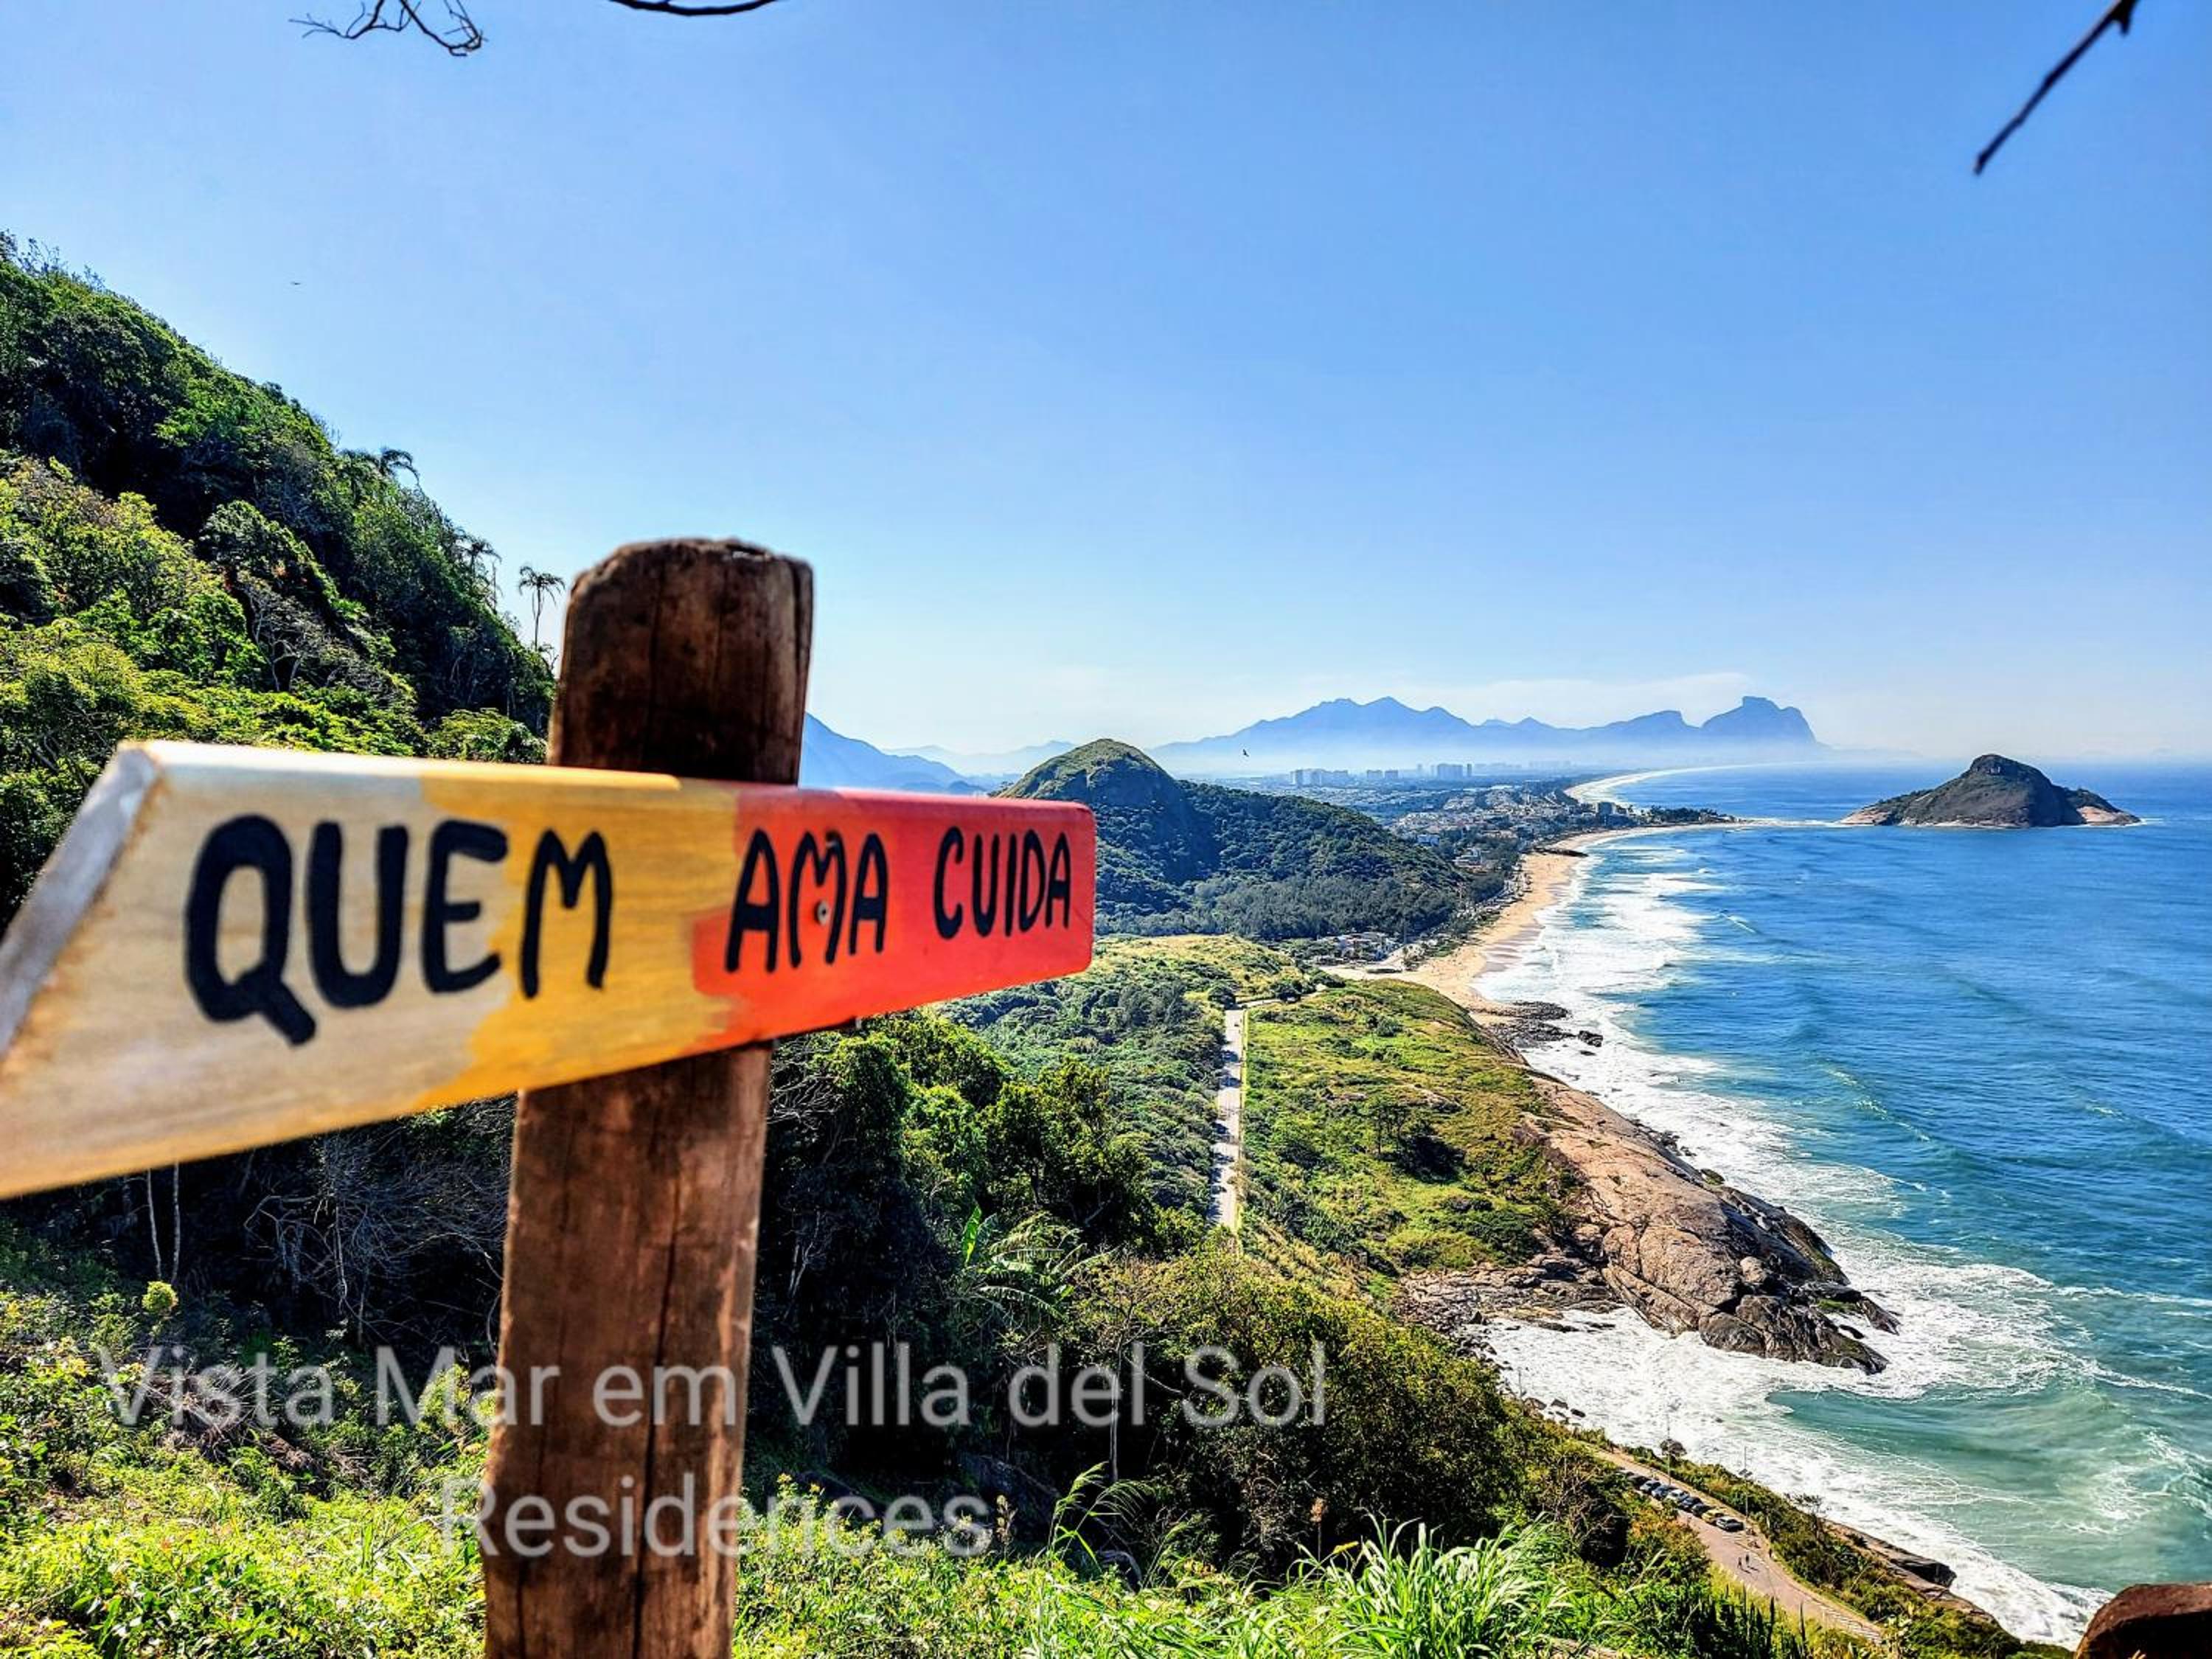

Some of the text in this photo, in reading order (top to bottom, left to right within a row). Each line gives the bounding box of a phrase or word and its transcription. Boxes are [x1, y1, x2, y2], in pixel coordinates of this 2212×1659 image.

[184, 814, 1071, 1046] QUEM AMA CUIDA
